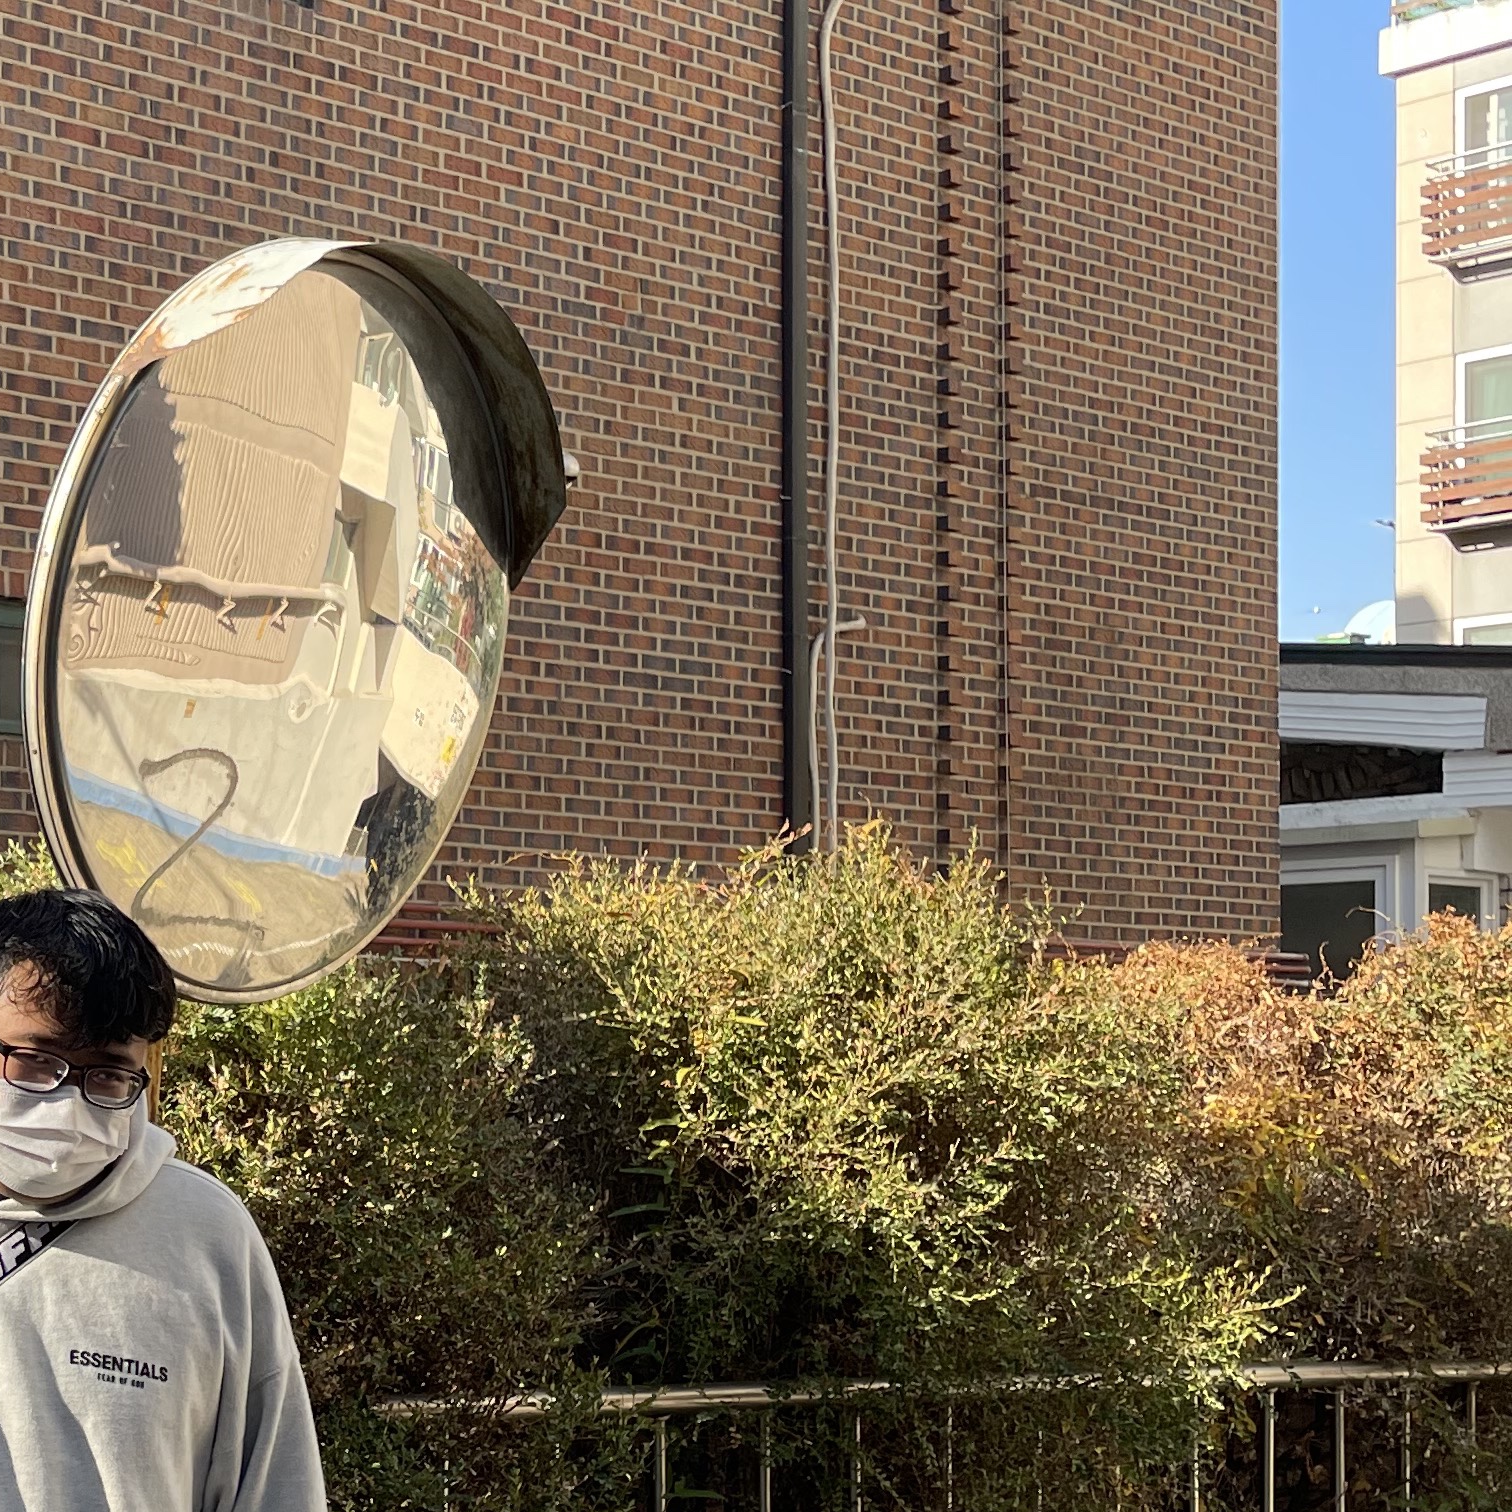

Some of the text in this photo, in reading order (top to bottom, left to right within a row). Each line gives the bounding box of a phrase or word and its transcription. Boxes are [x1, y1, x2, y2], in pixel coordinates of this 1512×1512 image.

[70, 1349, 168, 1382] ESSENTIALS
[97, 1372, 116, 1383] FEAR
[119, 1377, 128, 1385] OF
